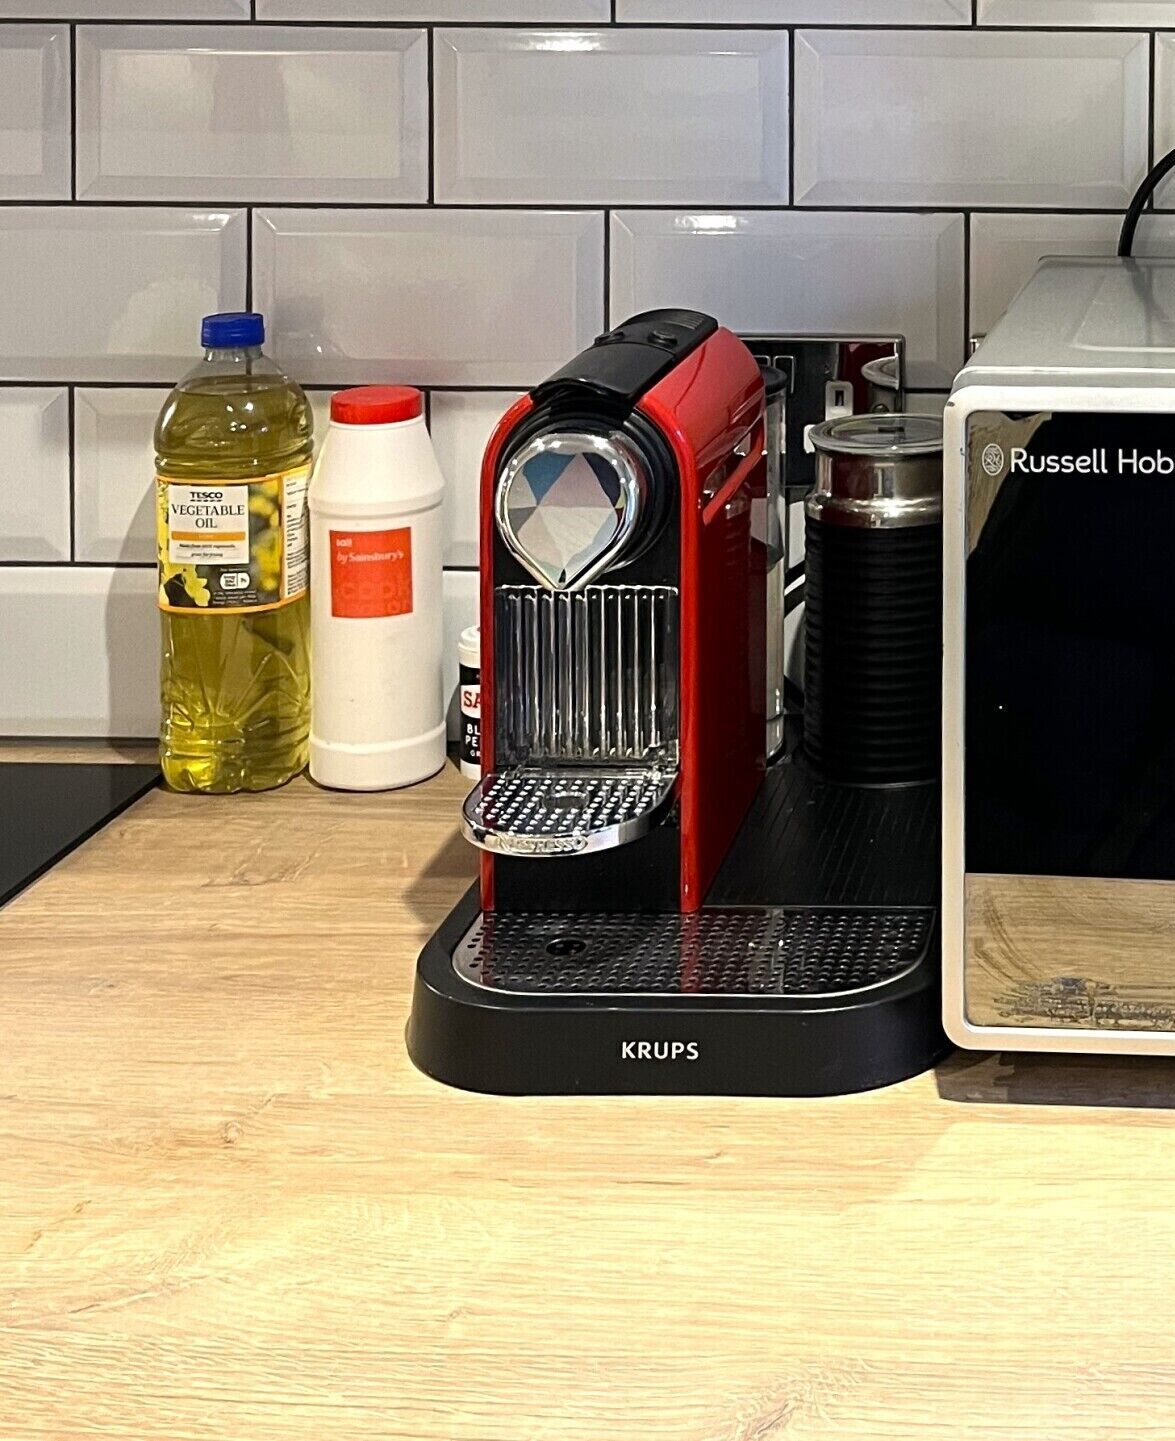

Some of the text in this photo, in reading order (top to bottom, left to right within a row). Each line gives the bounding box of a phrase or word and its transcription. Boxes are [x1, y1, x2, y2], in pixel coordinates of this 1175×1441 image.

[1010, 447, 1108, 473] Russell
[189, 491, 224, 499] TESCO
[171, 503, 246, 516] VEGETABLE
[195, 517, 218, 529] OIL
[336, 550, 349, 565] by
[621, 1041, 699, 1060] KRUPS
